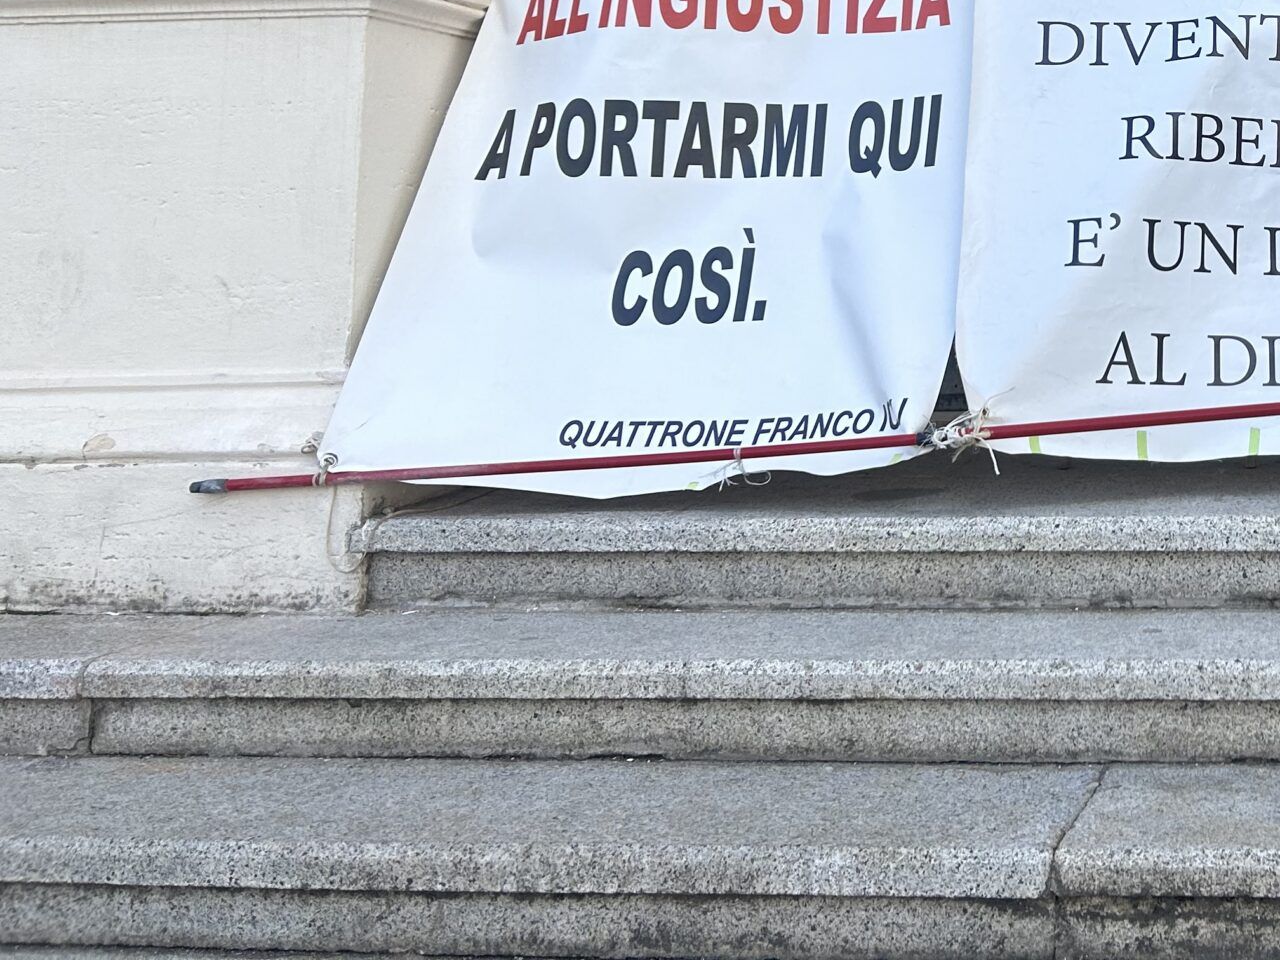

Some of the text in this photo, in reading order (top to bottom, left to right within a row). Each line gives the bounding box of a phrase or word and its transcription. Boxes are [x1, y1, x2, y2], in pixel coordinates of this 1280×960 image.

[474, 93, 943, 181] A PORTARMI QUI
[1064, 212, 1121, 267] E'
[1142, 218, 1245, 275] UN
[611, 227, 767, 327] COSÌ.
[1095, 330, 1187, 386] AL
[559, 419, 749, 449] QUATTRONE
[751, 408, 875, 446] FRANCO
